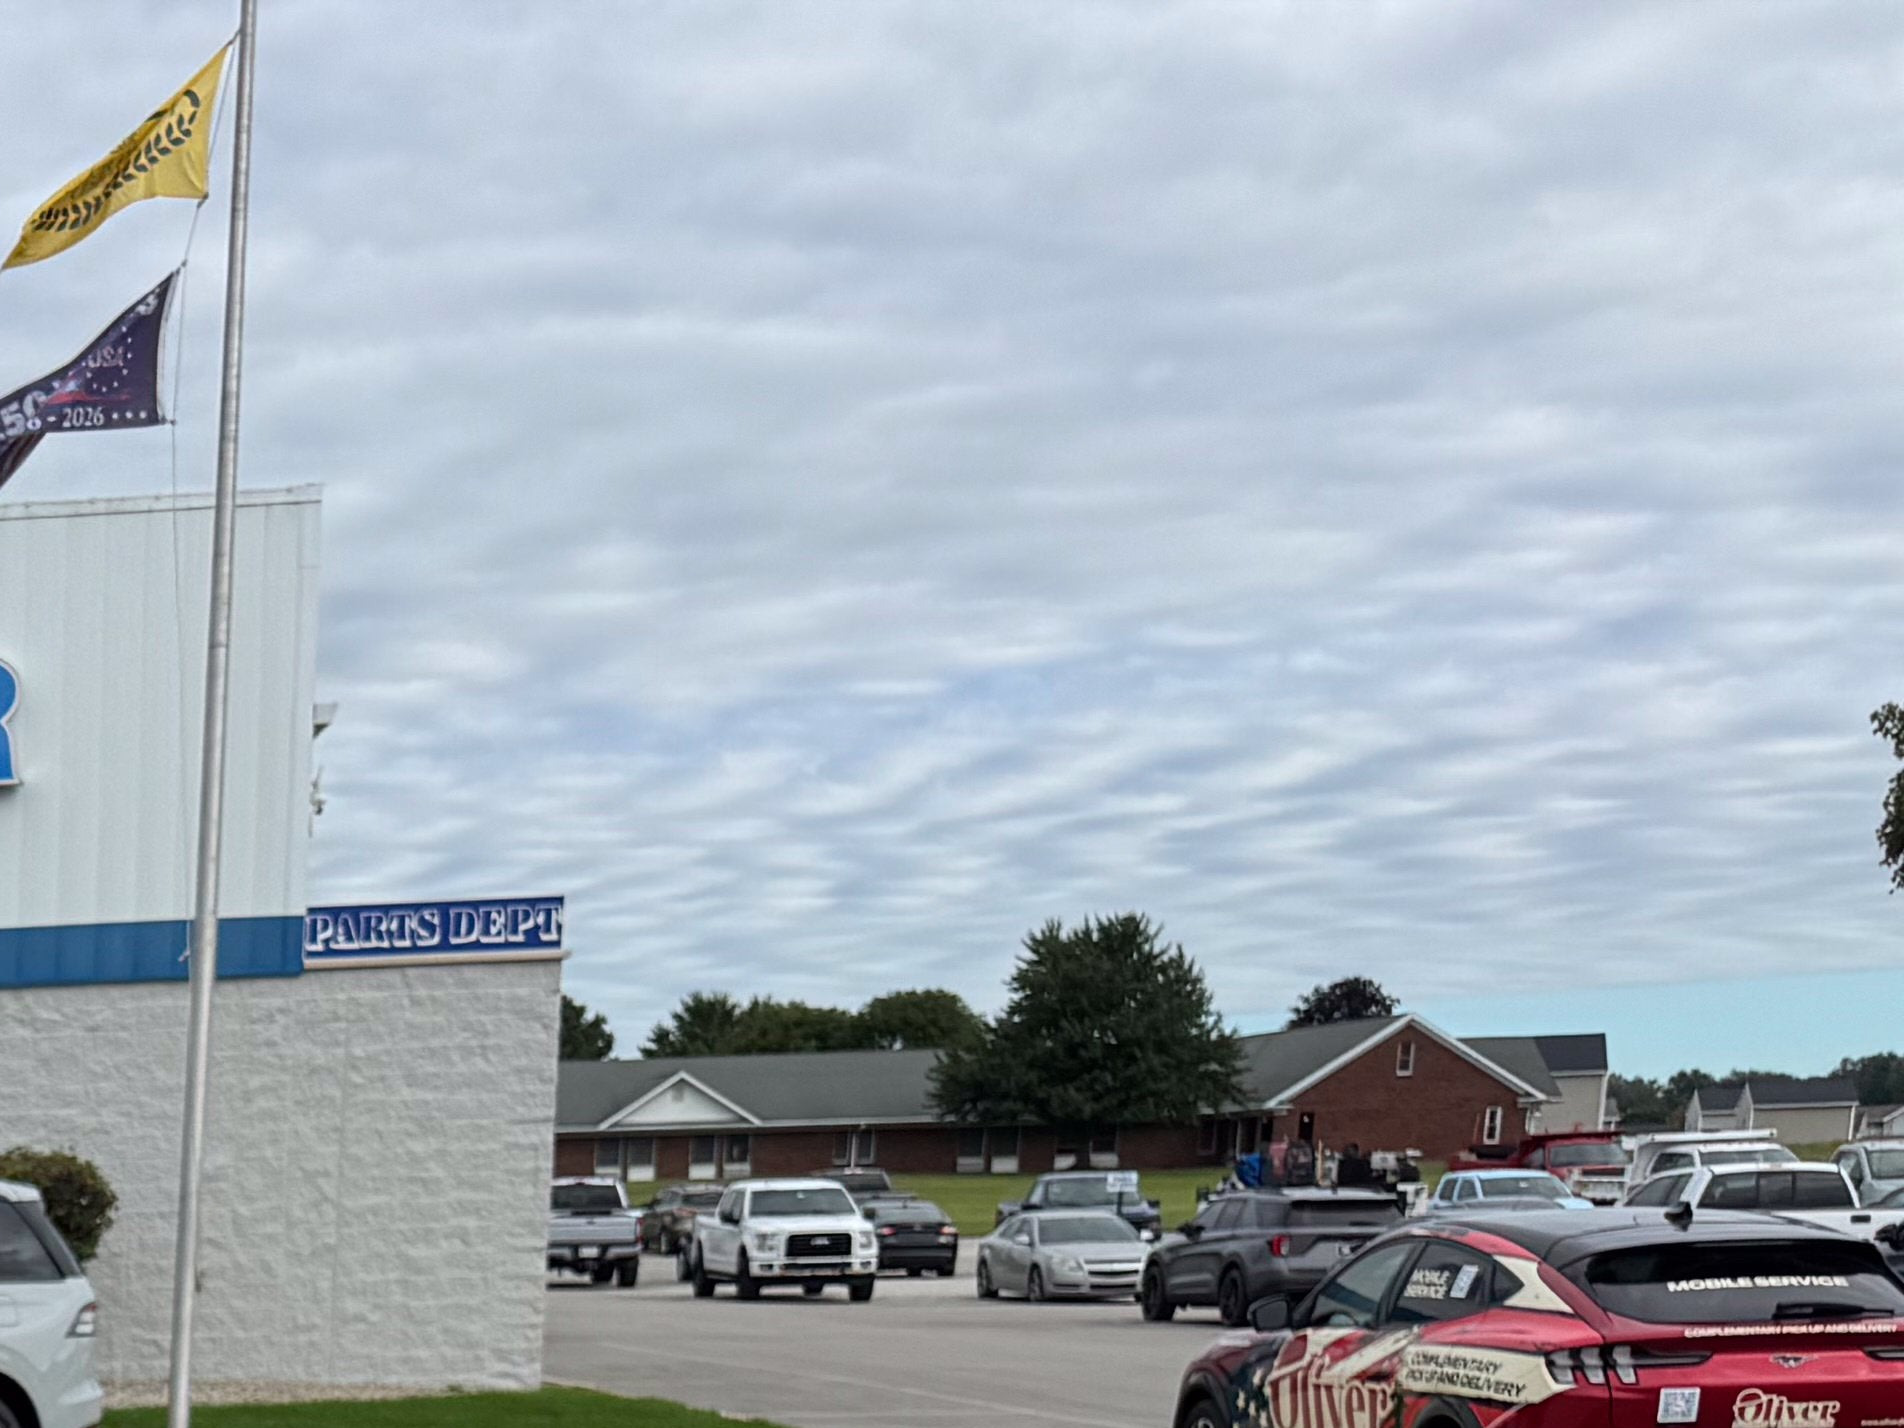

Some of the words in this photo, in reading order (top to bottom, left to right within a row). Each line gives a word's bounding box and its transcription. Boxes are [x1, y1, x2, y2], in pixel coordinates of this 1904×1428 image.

[62, 408, 104, 427] 2026
[305, 906, 441, 952] PARTS
[1666, 1276, 1753, 1292] MOBILE
[1753, 1275, 1849, 1288] SERVICE
[1460, 1373, 1526, 1397] DELIVERY
[1733, 1387, 1840, 1427] Oliver
